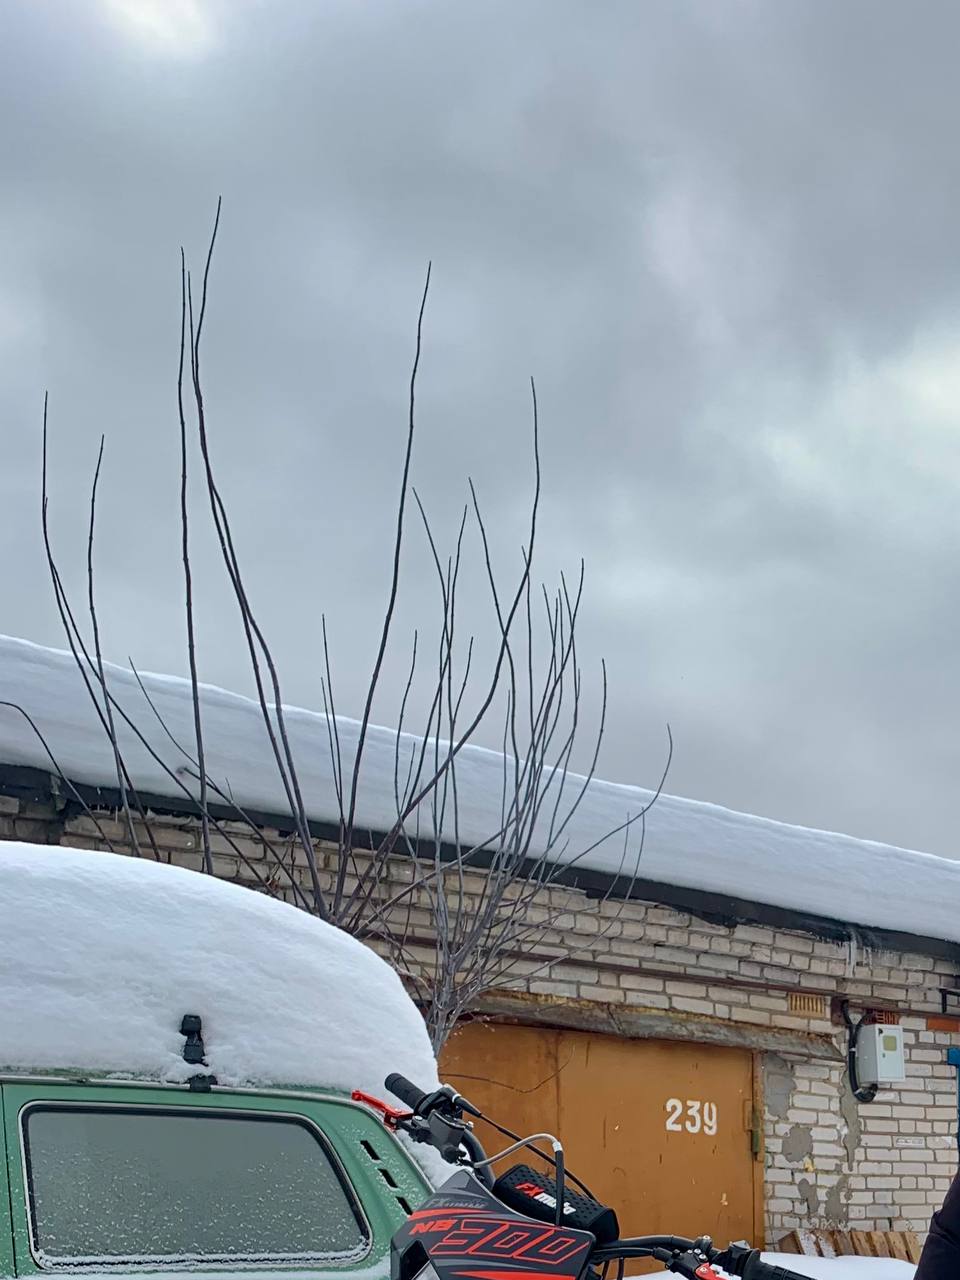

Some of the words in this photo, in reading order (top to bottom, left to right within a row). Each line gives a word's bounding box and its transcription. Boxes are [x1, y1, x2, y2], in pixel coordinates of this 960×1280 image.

[665, 1097, 718, 1136] 239
[515, 1181, 577, 1216] FXmoo
[428, 1218, 591, 1266] 300
